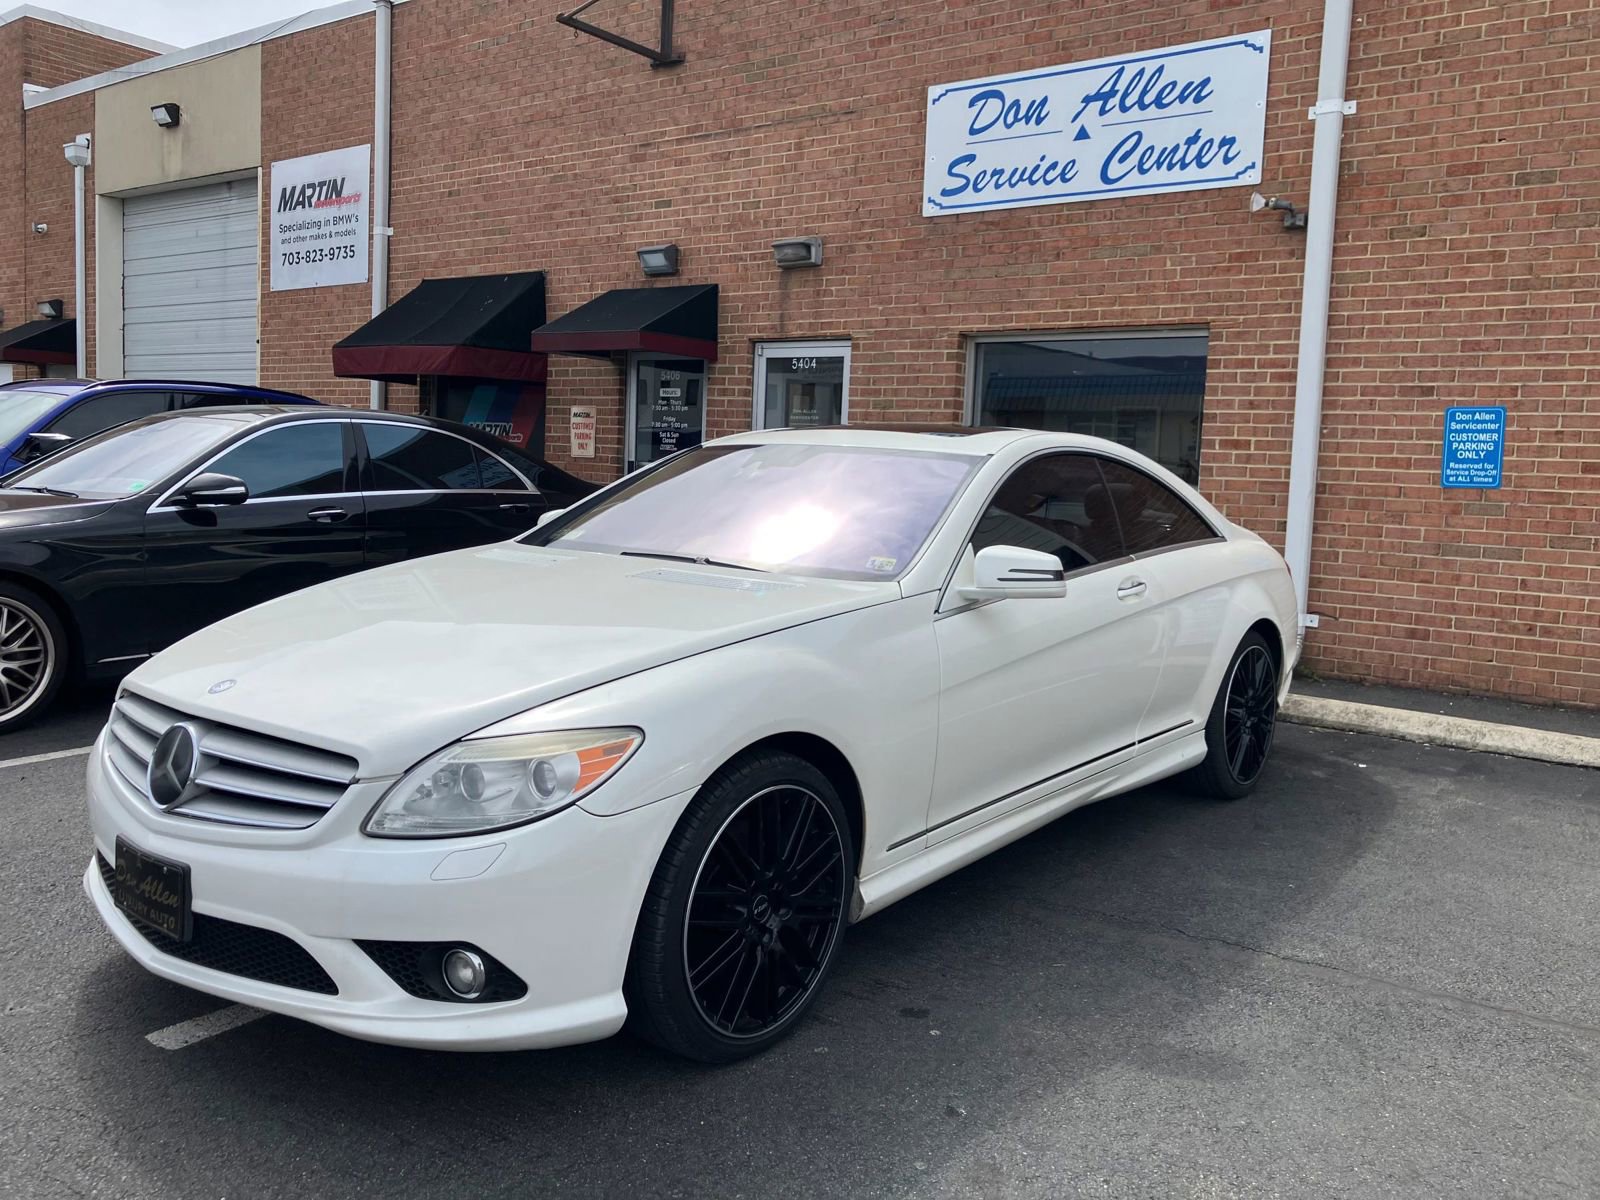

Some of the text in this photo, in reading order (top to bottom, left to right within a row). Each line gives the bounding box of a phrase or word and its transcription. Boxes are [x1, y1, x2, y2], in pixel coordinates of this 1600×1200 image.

[968, 63, 1214, 136] Don Allen
[940, 128, 1241, 197] Service Center
[277, 177, 346, 213] MARTIN
[279, 213, 359, 234] Specializing in BMW's
[280, 227, 357, 245] and other makes & models
[281, 244, 356, 267] 703-823-9735
[791, 357, 817, 370] 5404
[661, 370, 681, 380] 5406
[1455, 411, 1496, 420] Don Allen
[572, 422, 594, 430] CUSTOMER
[1450, 421, 1500, 430] Servicenter
[574, 431, 592, 440] PARKING
[1449, 432, 1499, 441] CUSTOMER
[577, 442, 588, 450] ONLY
[1452, 442, 1494, 451] PARKING
[1457, 450, 1486, 459] ONLY
[134, 875, 178, 908] Allen
[149, 908, 176, 929] AUTO
